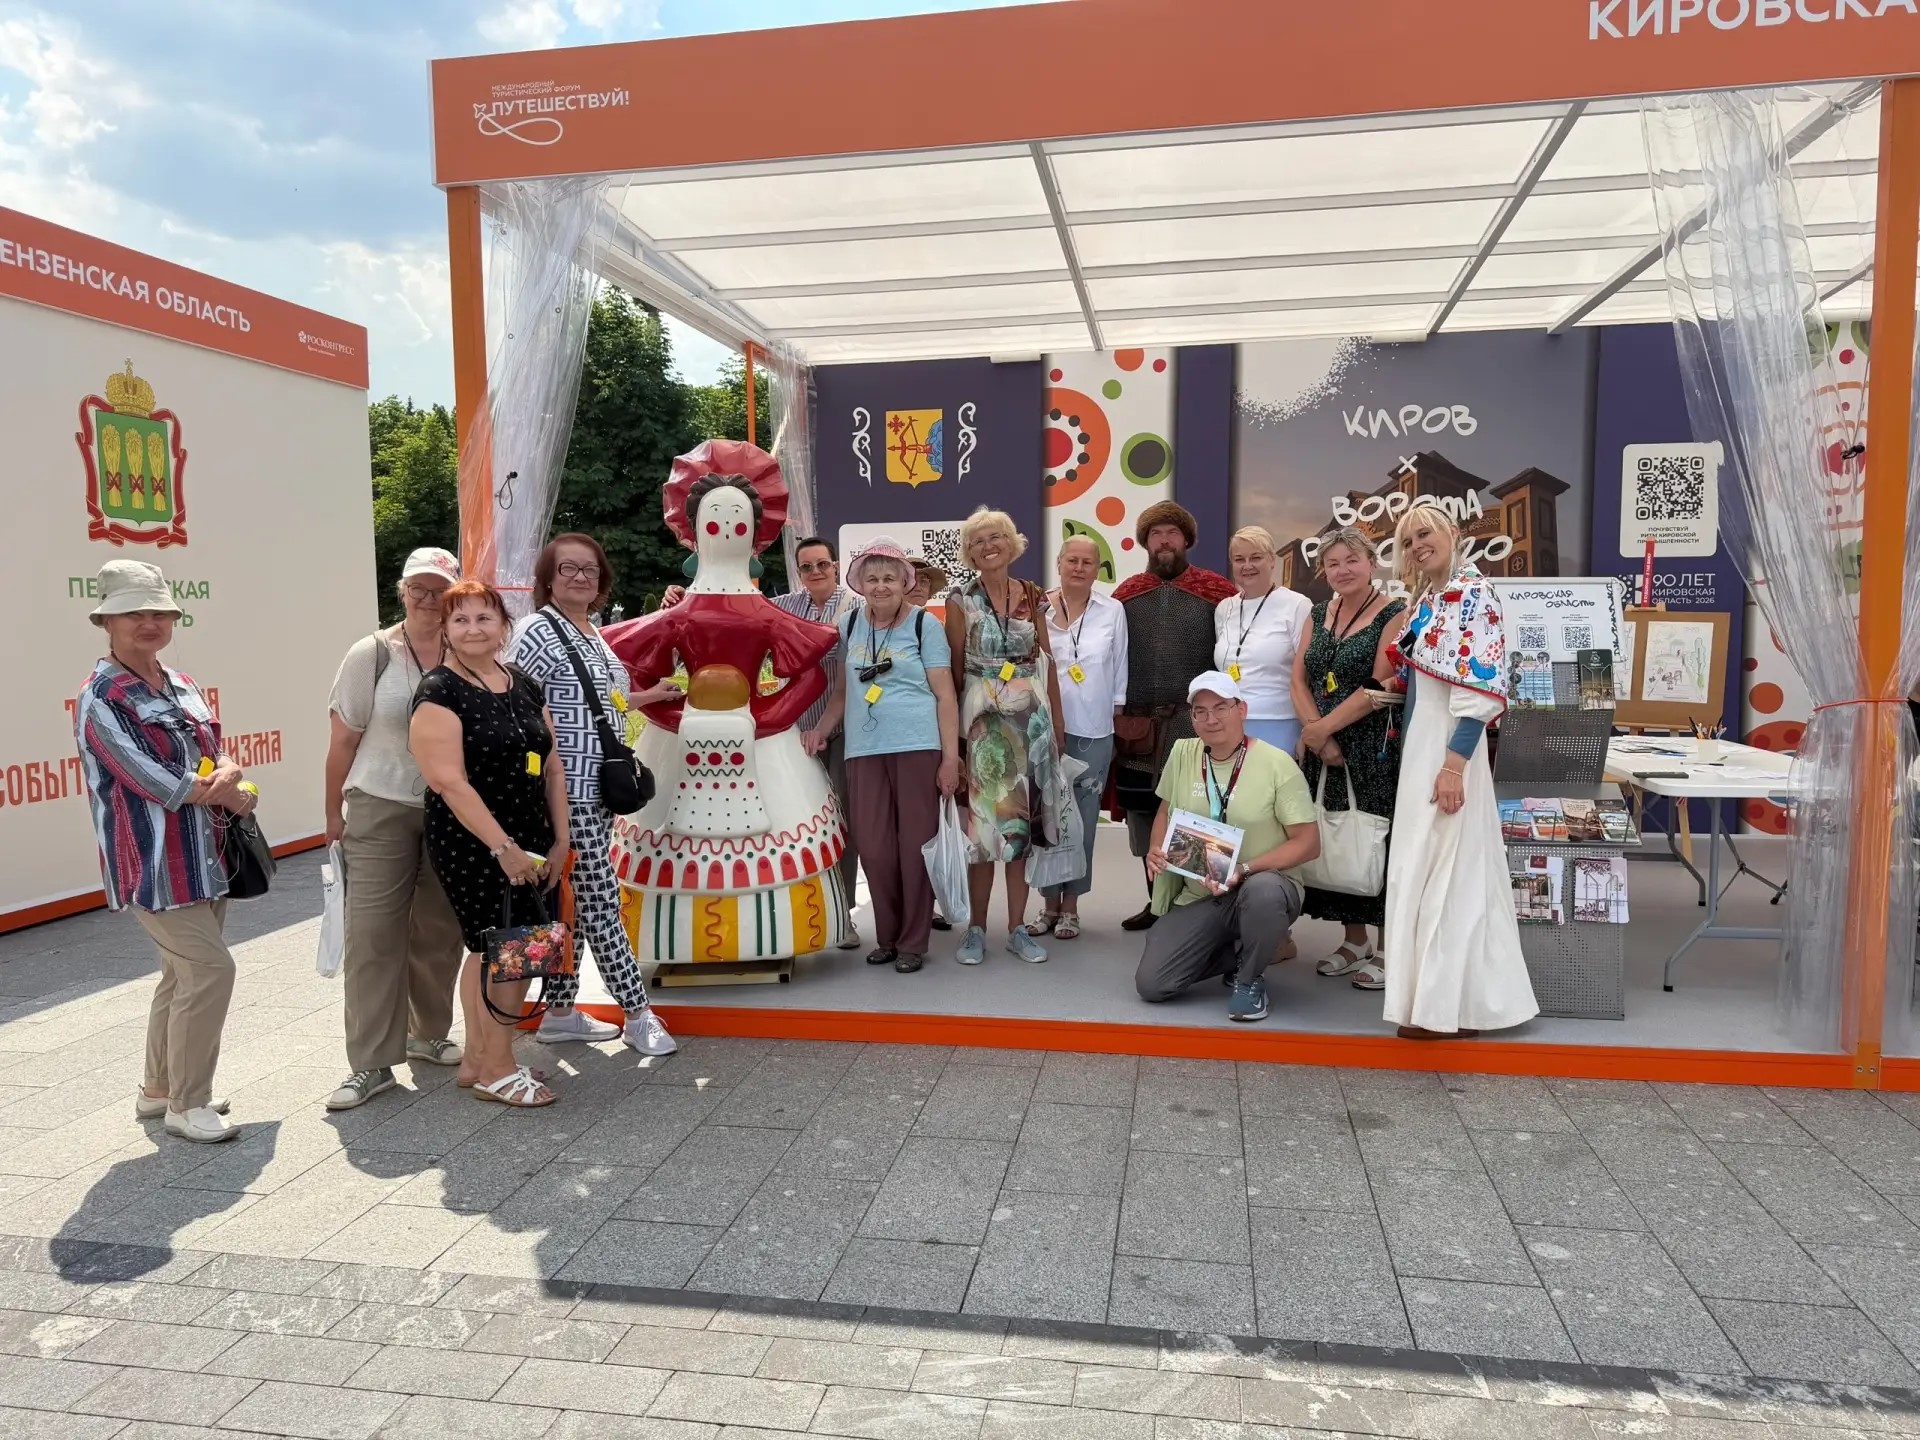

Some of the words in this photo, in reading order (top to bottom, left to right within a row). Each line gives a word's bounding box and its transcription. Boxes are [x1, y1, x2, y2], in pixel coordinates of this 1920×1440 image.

[491, 79, 555, 91] МЕЖДУНАРОДНЫЙ
[492, 85, 553, 98] ТУРИСТИЧЕСКИЙ
[553, 84, 581, 92] ФОРУМ
[492, 87, 630, 116] ПУТЕШЕСТВУЙ!
[155, 287, 251, 332] ОБЛАСТЬ
[1342, 405, 1478, 439] КИРОВ
[1652, 573, 1677, 587] 90
[1679, 573, 1716, 587] ЛЕТ
[1508, 590, 1574, 601] КИРОВСКАЯ
[1652, 588, 1716, 597] КИРОВСКАЯ
[1545, 599, 1595, 608] ОБЛАСТЬ
